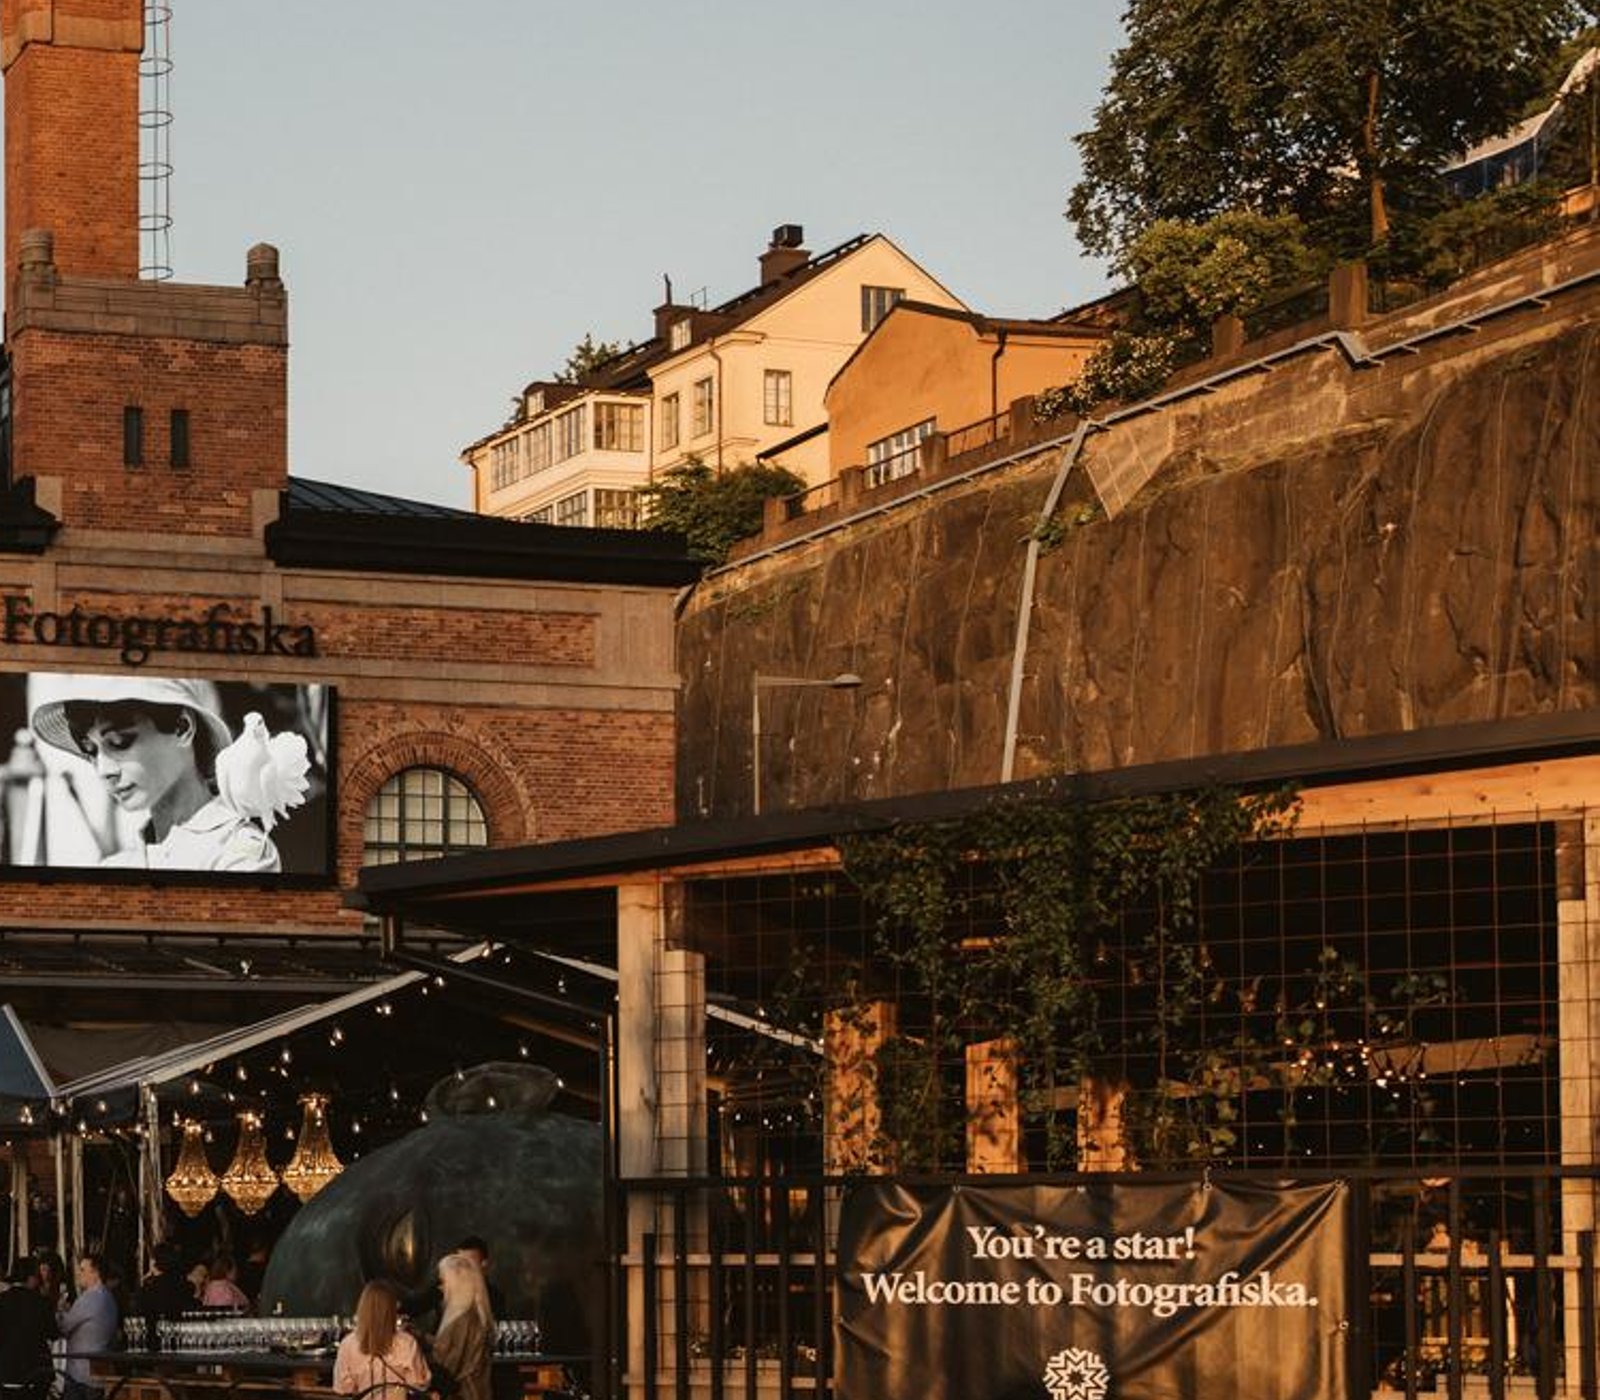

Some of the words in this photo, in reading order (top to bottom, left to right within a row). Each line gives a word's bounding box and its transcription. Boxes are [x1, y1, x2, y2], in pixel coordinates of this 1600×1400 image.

[3, 595, 320, 667] Fotografiska
[1085, 1236, 1108, 1260] a
[1113, 1226, 1196, 1260] star!
[859, 1270, 1021, 1305] Welcome
[1026, 1276, 1064, 1305] to
[1068, 1270, 1319, 1318] Fotografiska.
